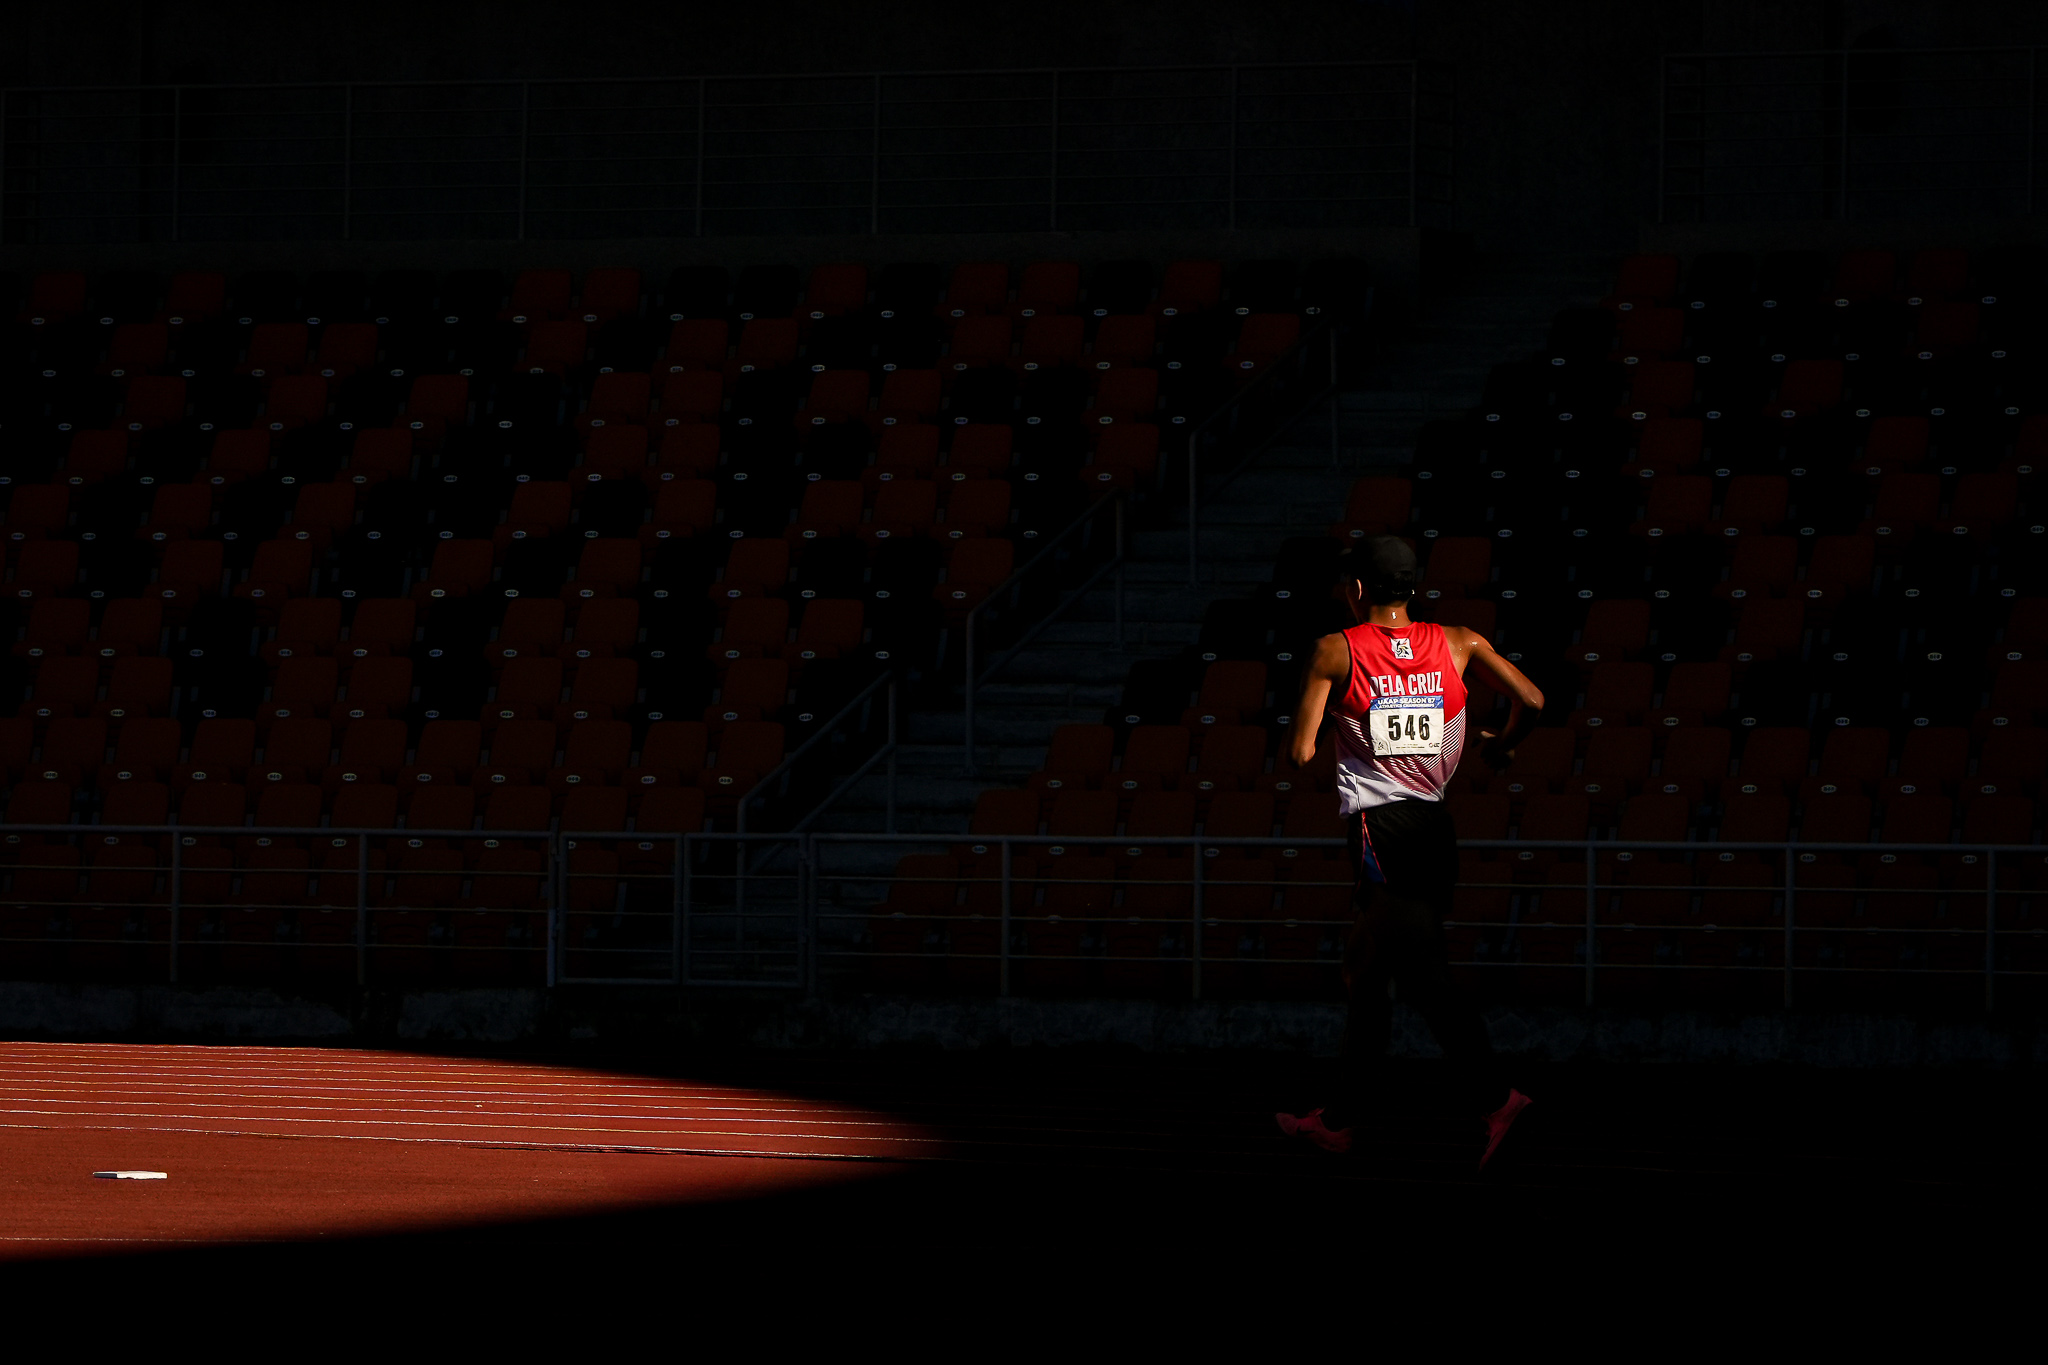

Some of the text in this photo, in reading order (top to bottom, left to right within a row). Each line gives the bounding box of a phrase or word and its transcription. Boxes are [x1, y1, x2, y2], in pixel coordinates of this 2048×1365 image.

[1369, 671, 1443, 697] DELA CRUZ
[1377, 697, 1399, 705] UAAP
[1387, 714, 1430, 741] 546
